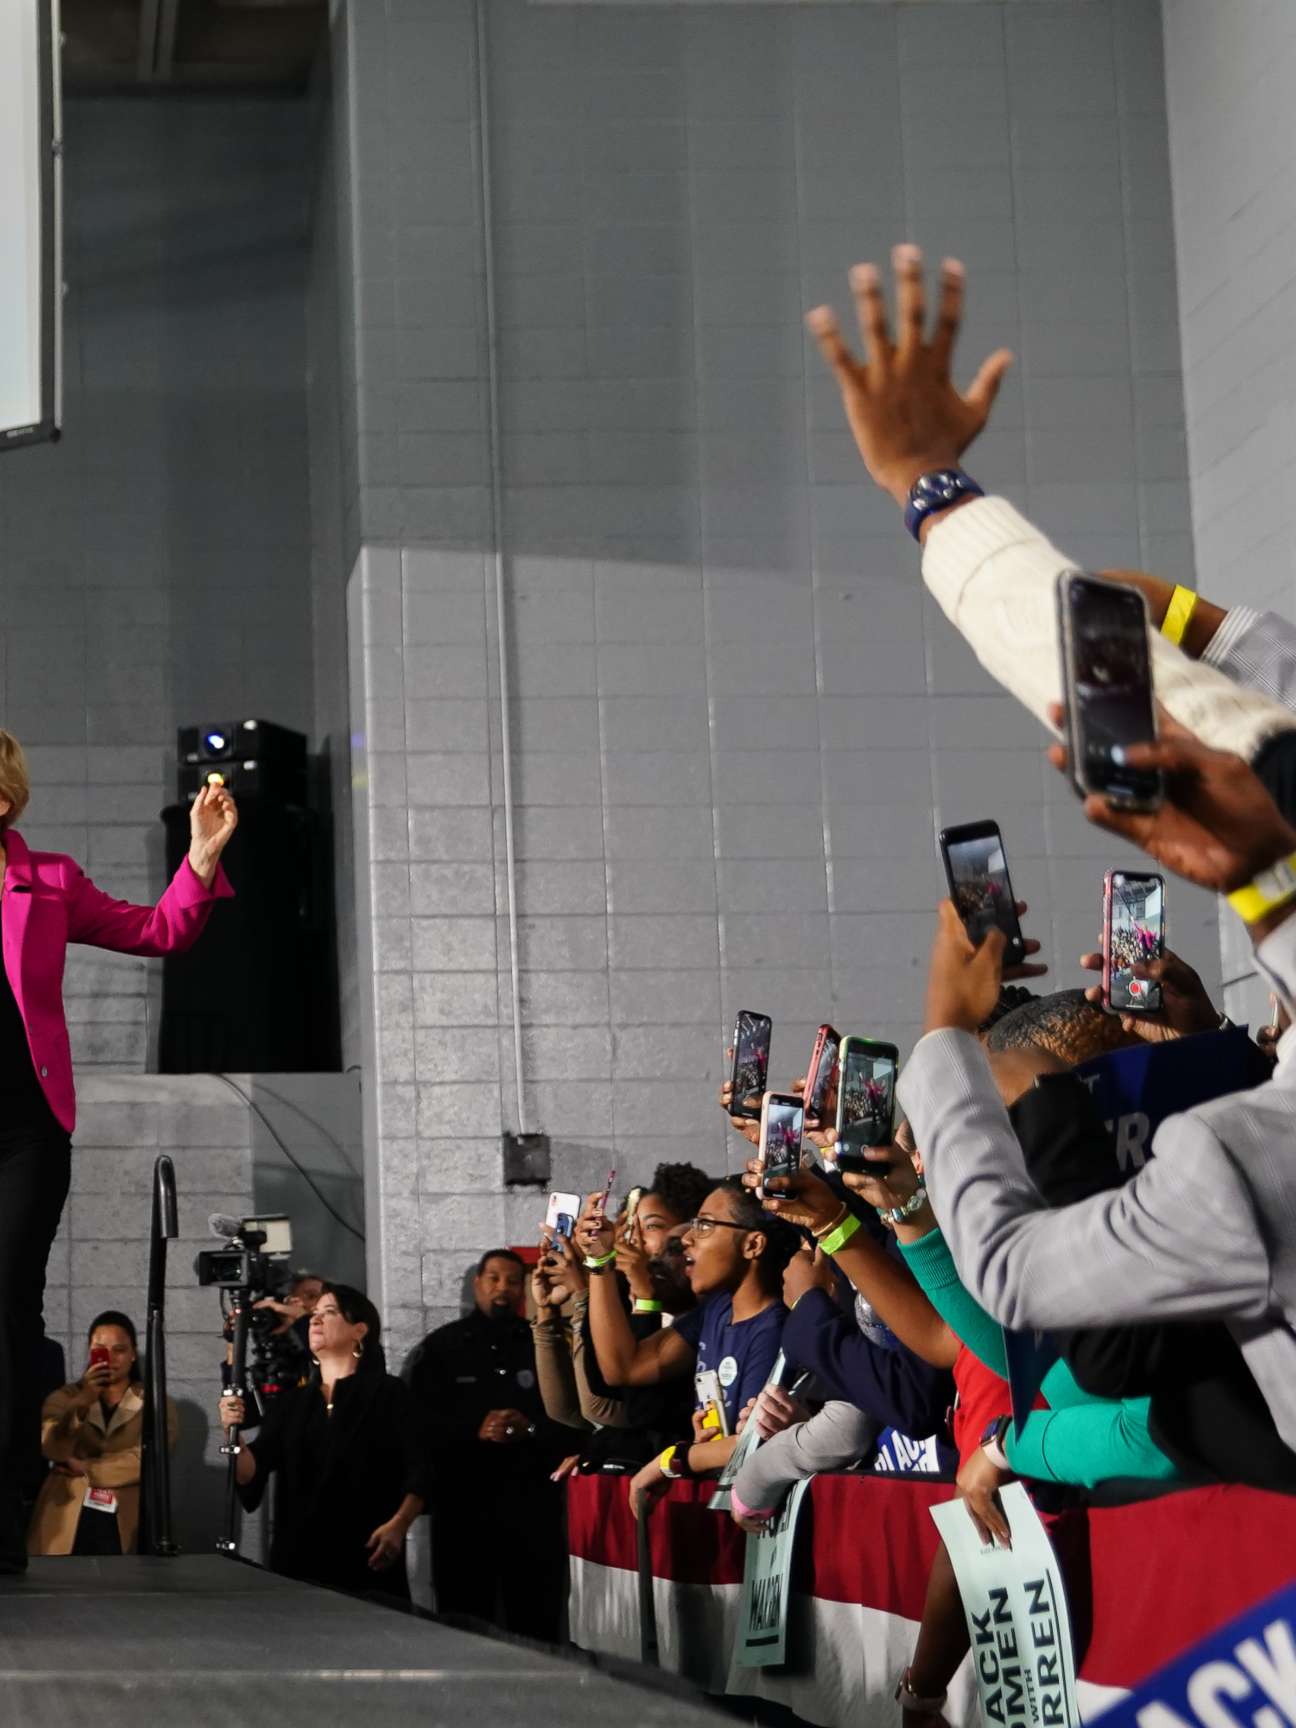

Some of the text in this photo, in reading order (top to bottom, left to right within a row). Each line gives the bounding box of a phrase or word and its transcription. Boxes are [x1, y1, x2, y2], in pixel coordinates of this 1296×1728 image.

[1104, 1111, 1150, 1171] R
[989, 1586, 1027, 1728] MEN
[1024, 1669, 1040, 1723] WITH
